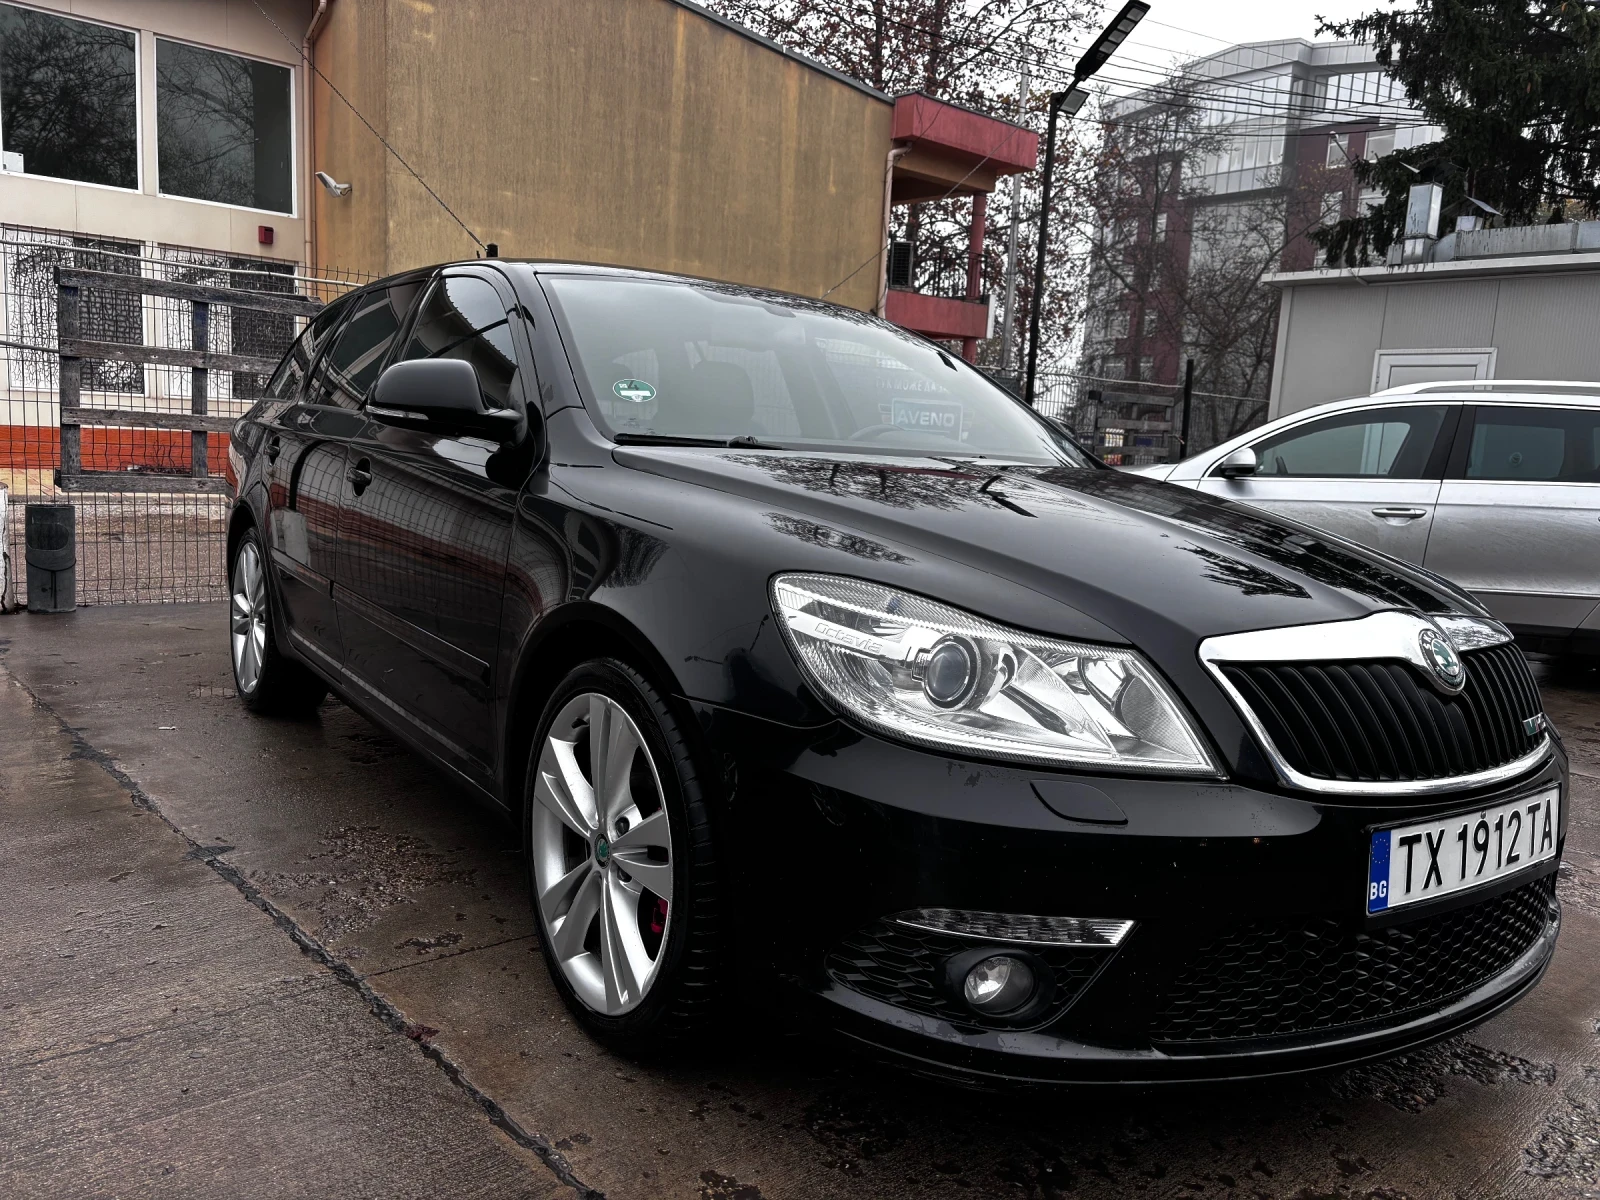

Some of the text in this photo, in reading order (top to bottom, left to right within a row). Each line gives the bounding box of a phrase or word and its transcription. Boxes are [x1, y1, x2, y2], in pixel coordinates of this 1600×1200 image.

[897, 409, 955, 427] AVENO
[814, 622, 884, 654] Octavia
[1400, 798, 1553, 894] TX 1912 TA
[1370, 880, 1387, 900] BG
